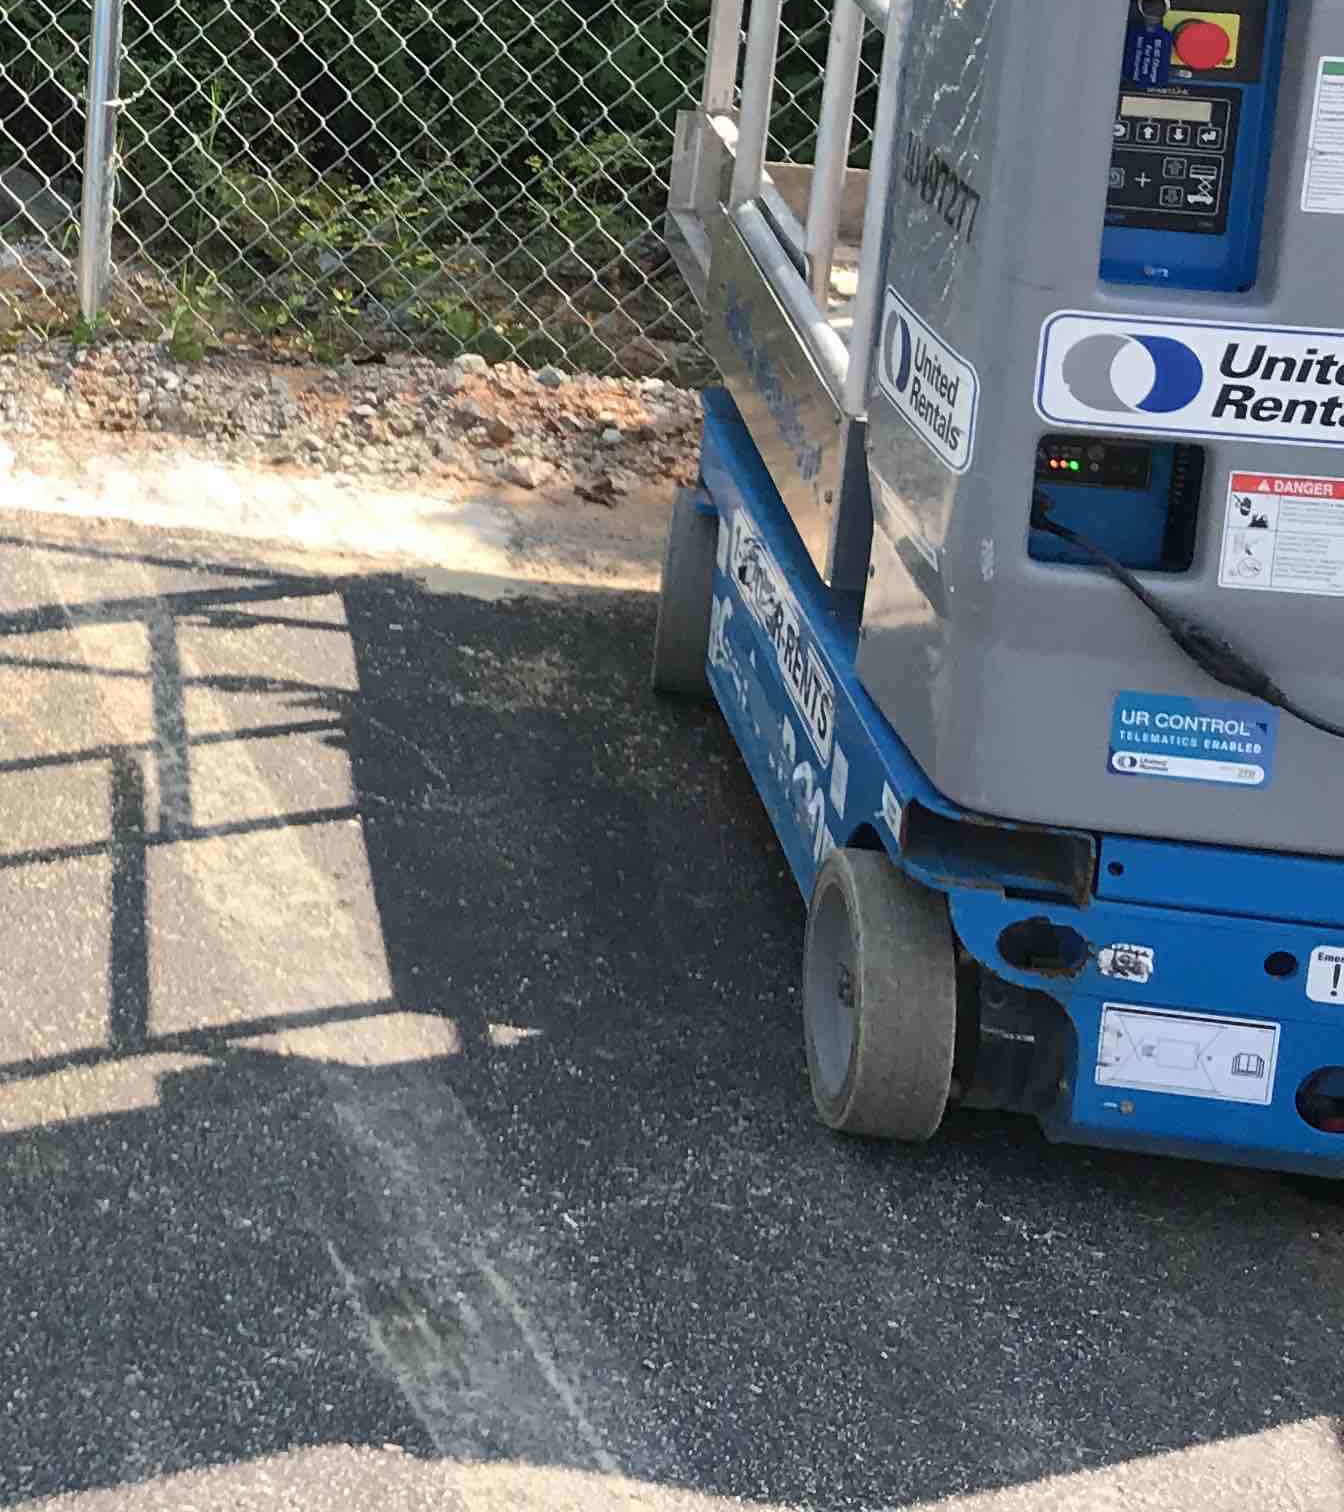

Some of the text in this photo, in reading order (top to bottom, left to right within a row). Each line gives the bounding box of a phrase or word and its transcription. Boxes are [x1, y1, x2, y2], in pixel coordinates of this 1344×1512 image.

[914, 337, 960, 408] United
[909, 376, 962, 452] Rentals
[1211, 383, 1344, 428] Rent
[1274, 478, 1333, 496] DANGER
[1120, 709, 1251, 737] UR CONTROL
[1120, 729, 1262, 754] TELEMATICS ENABLED
